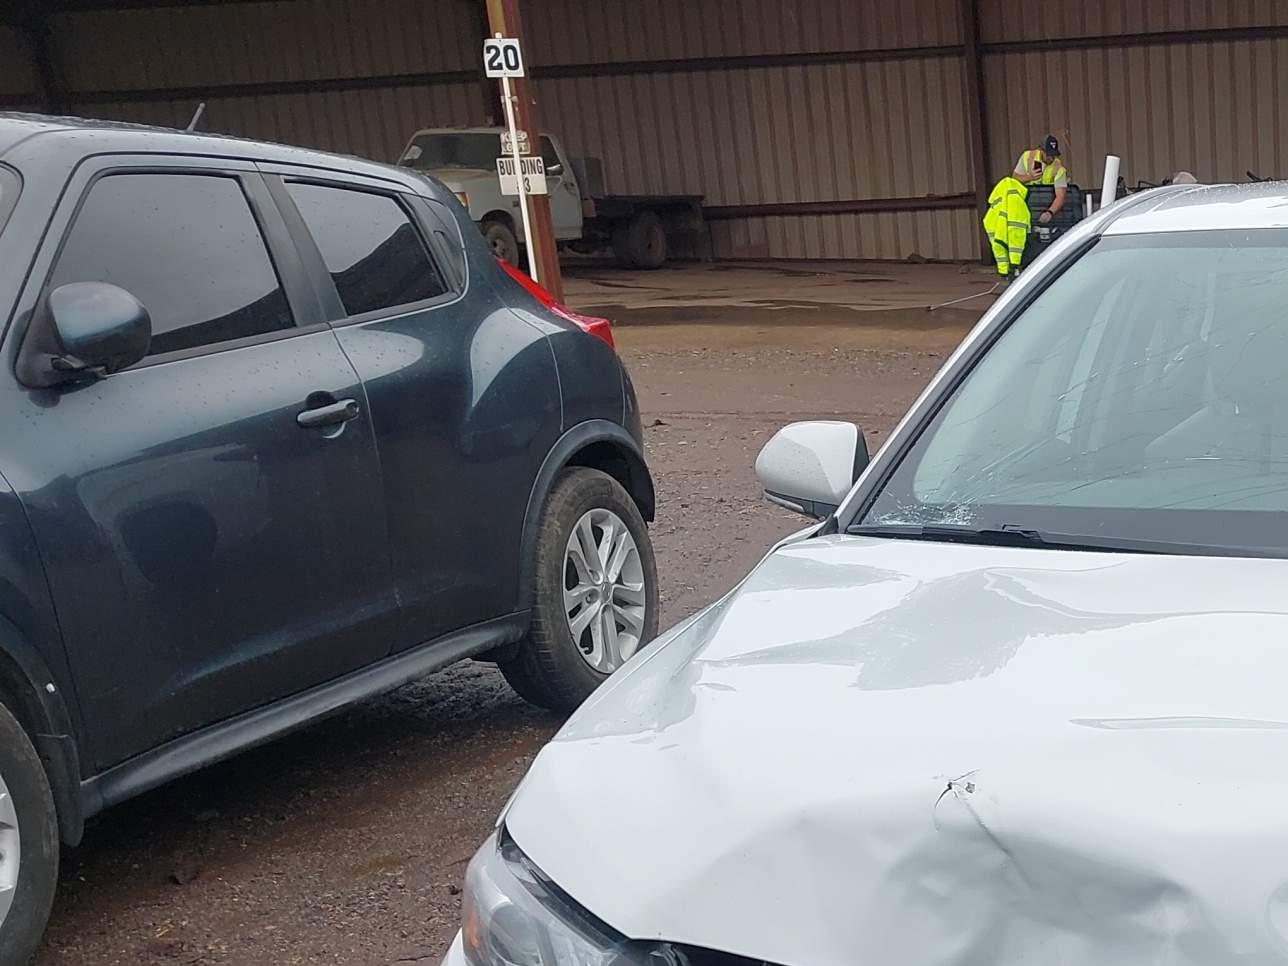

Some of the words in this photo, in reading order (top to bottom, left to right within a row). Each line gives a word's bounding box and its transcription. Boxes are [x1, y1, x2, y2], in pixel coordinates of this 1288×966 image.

[486, 45, 519, 70] 20
[502, 131, 527, 142] KEP
[505, 142, 526, 152] OT
[499, 159, 543, 175] BUIDING
